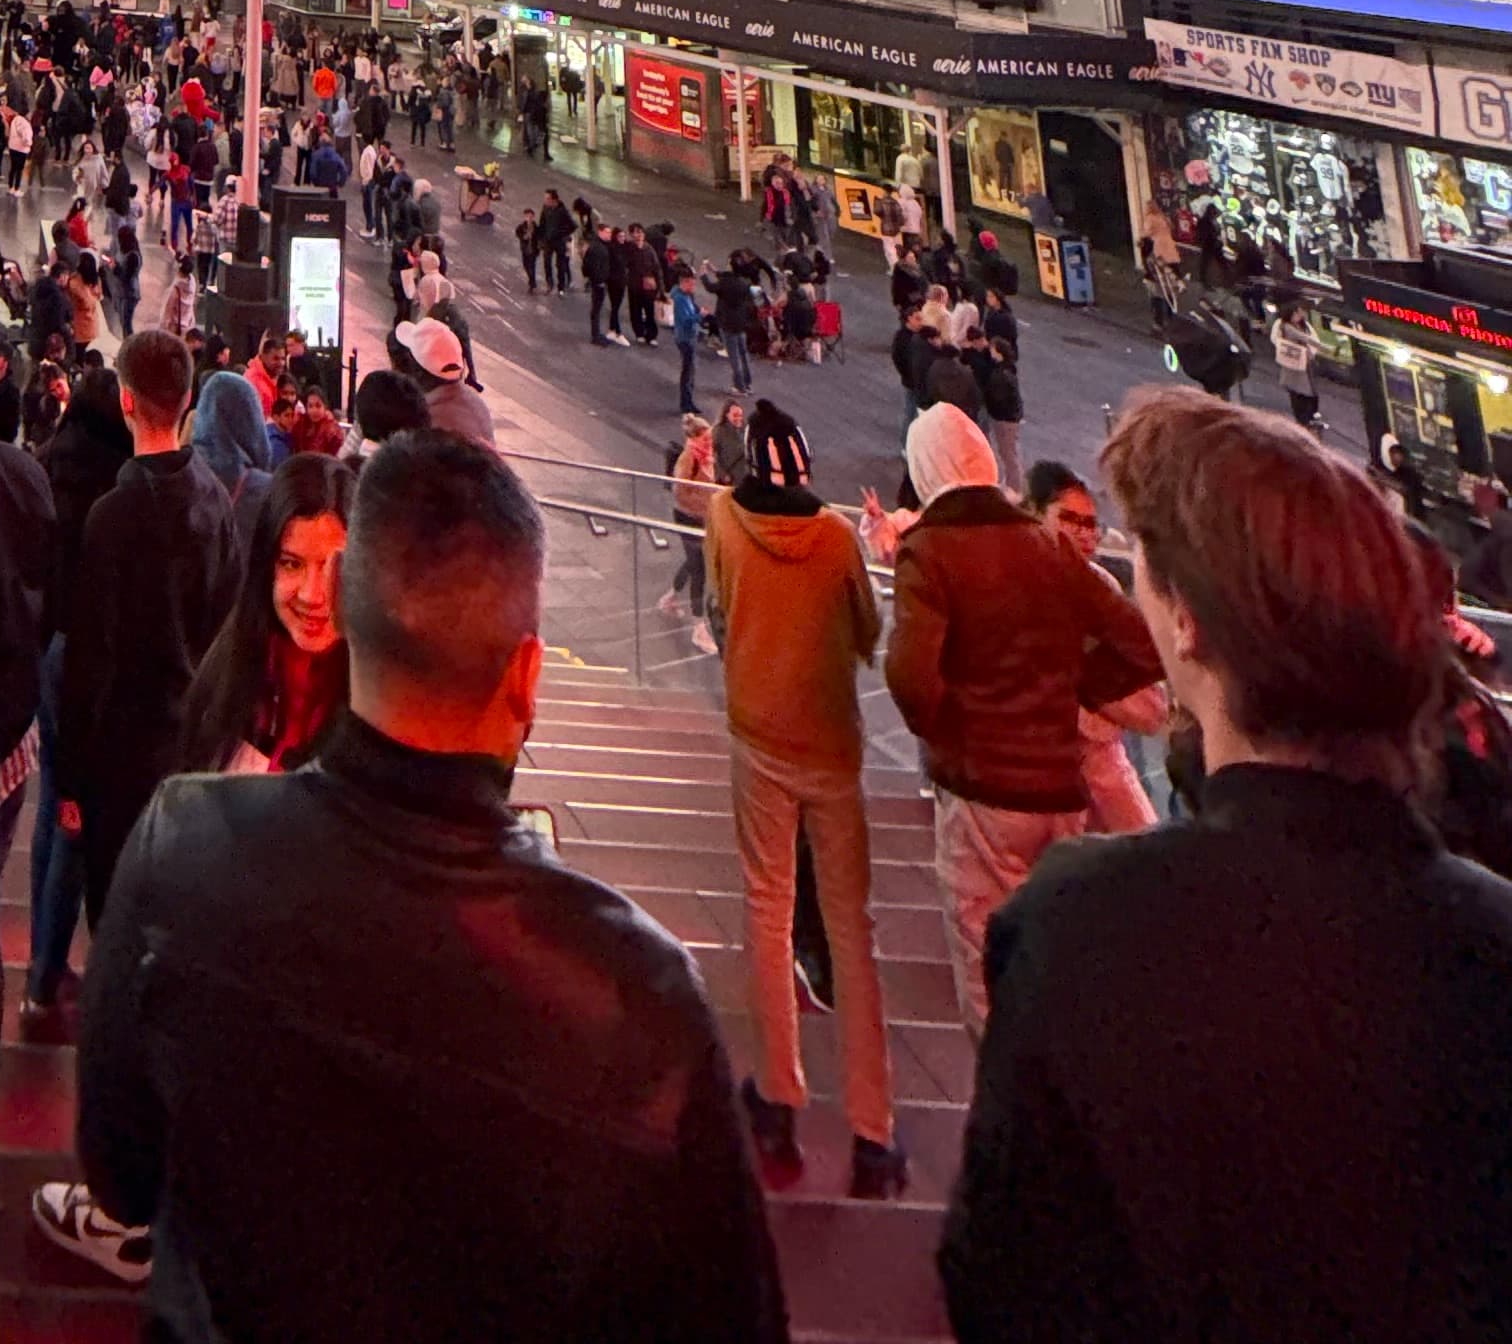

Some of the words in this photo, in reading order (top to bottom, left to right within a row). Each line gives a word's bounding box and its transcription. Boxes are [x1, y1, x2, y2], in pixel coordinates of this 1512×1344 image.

[634, 1, 690, 22] AMERICAN
[695, 11, 731, 30] EAGLE
[745, 20, 775, 39] aerie
[793, 31, 864, 57] AMERICAN
[871, 45, 918, 68] EAGLE
[933, 56, 973, 76] aerie
[1187, 28, 1247, 55] SPORTS
[1250, 39, 1284, 61] FAN
[1288, 44, 1332, 68] SHOP
[977, 60, 1059, 77] AMERICAN
[1067, 61, 1114, 80] EAGLE
